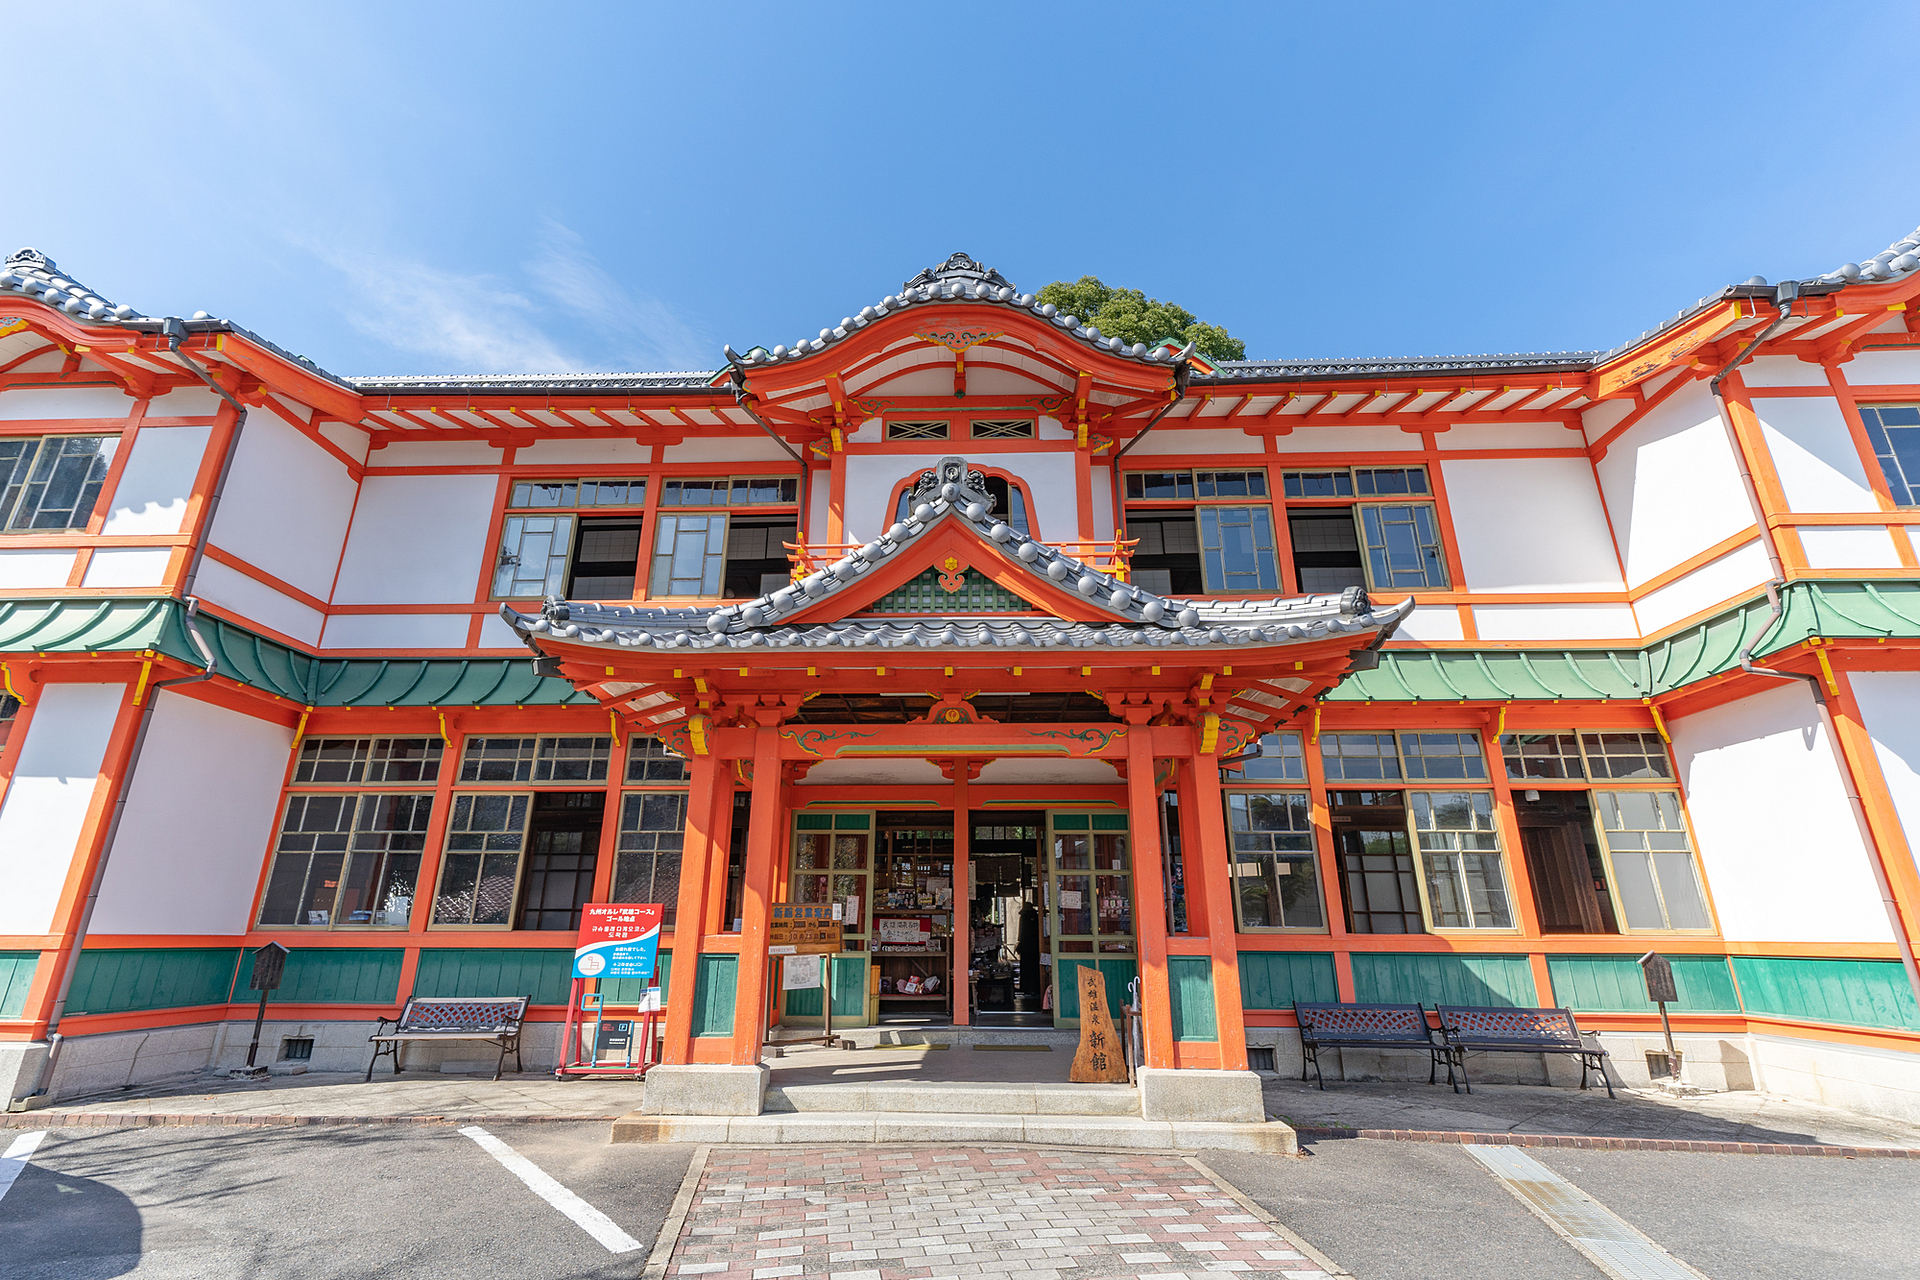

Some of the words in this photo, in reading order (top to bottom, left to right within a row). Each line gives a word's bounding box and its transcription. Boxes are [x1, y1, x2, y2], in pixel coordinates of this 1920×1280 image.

[774, 907, 832, 918] 新館営業案内
[1087, 978, 1107, 1071] 武雄温泉新館
